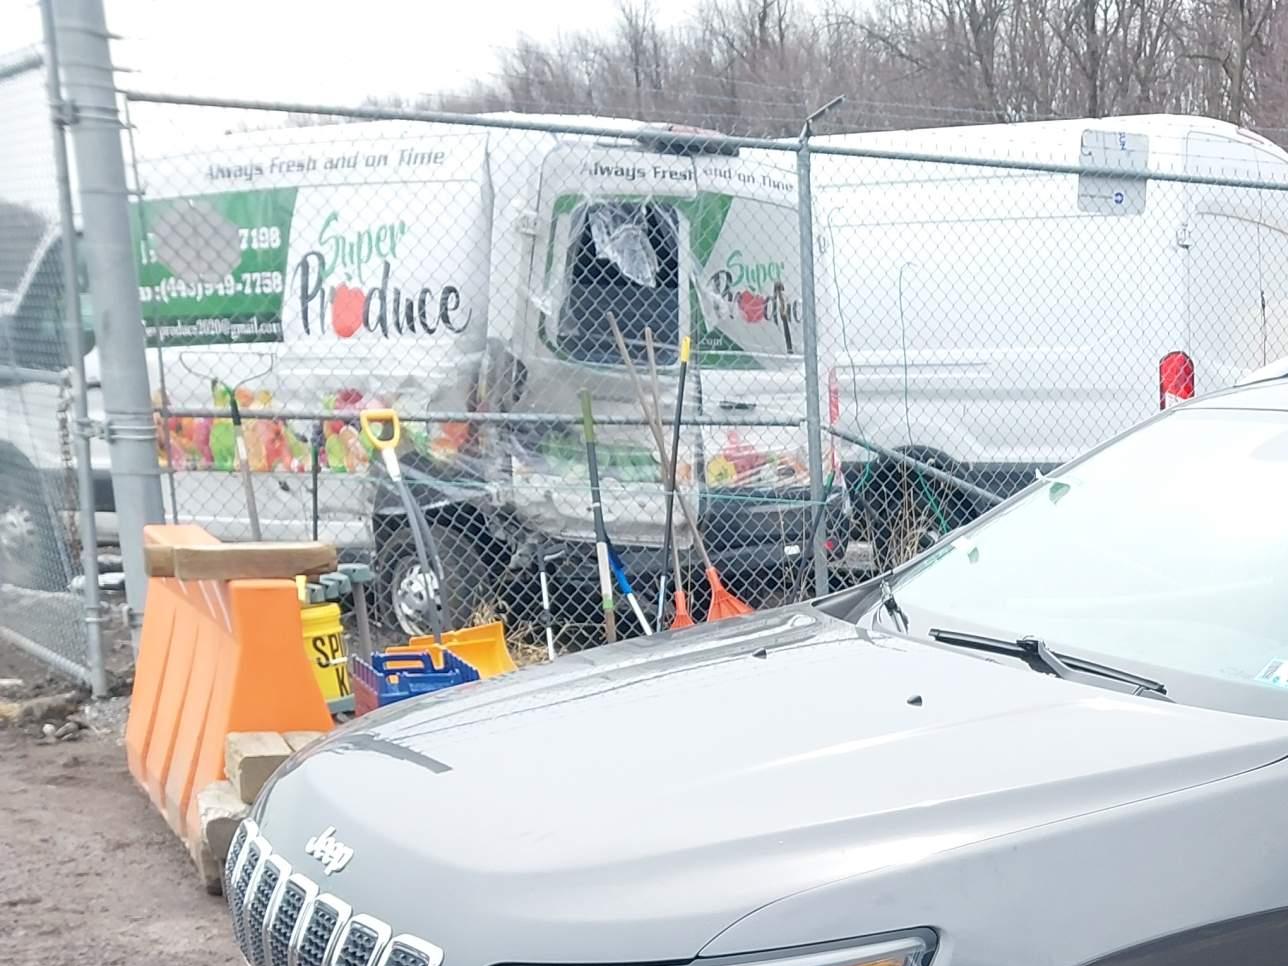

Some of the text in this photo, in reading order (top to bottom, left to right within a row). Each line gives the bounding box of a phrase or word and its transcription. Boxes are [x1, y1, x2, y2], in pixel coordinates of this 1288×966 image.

[269, 155, 317, 174] Fresh
[323, 151, 359, 170] and
[365, 154, 388, 168] on
[398, 147, 446, 166] Time
[580, 161, 646, 181] Always
[319, 211, 407, 286] Super
[726, 249, 785, 292] Super
[290, 251, 472, 339] Produce
[304, 825, 354, 876] Jeep
